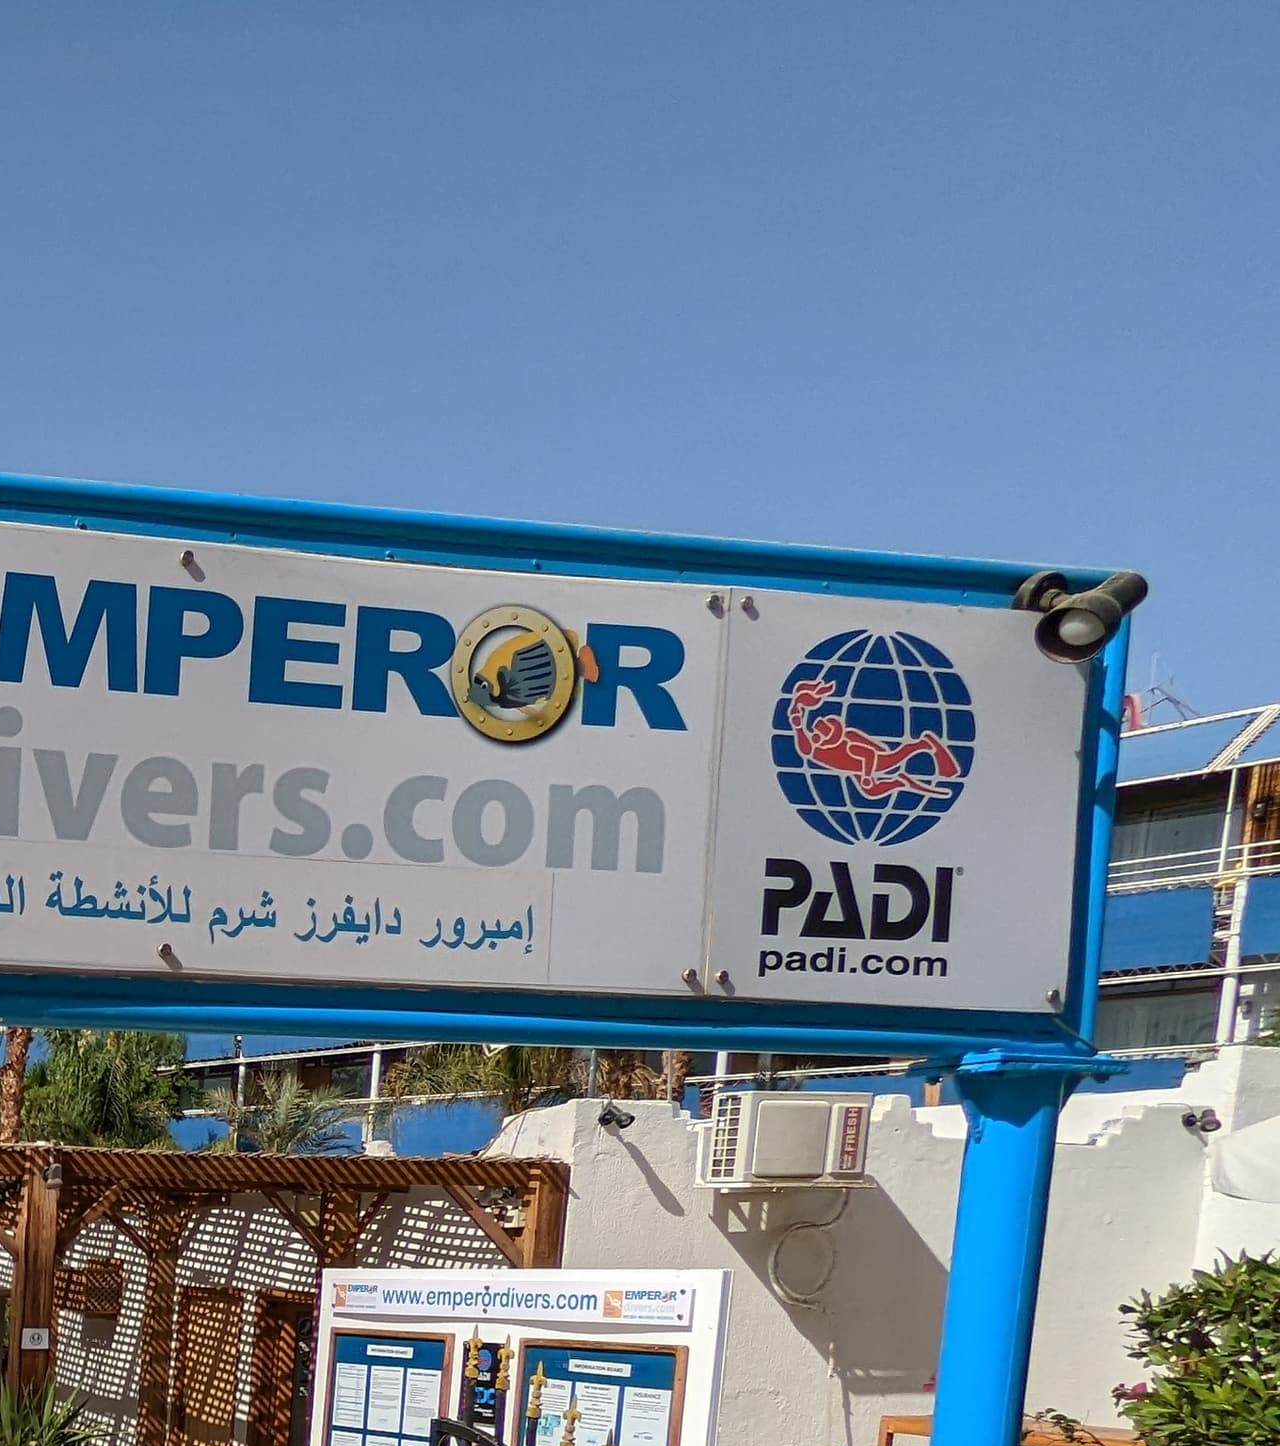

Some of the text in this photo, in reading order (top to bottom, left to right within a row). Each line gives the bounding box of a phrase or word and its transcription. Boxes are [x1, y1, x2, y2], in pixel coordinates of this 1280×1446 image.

[43, 867, 192, 926] للأنشطة
[208, 887, 279, 944] شرم
[291, 894, 402, 947] دايفرز
[760, 857, 955, 943] PADI
[418, 903, 536, 956] إمبرور
[757, 946, 949, 978] padi.com
[844, 1107, 859, 1151] FRESH
[382, 1287, 598, 1312] www.emperordivers.com
